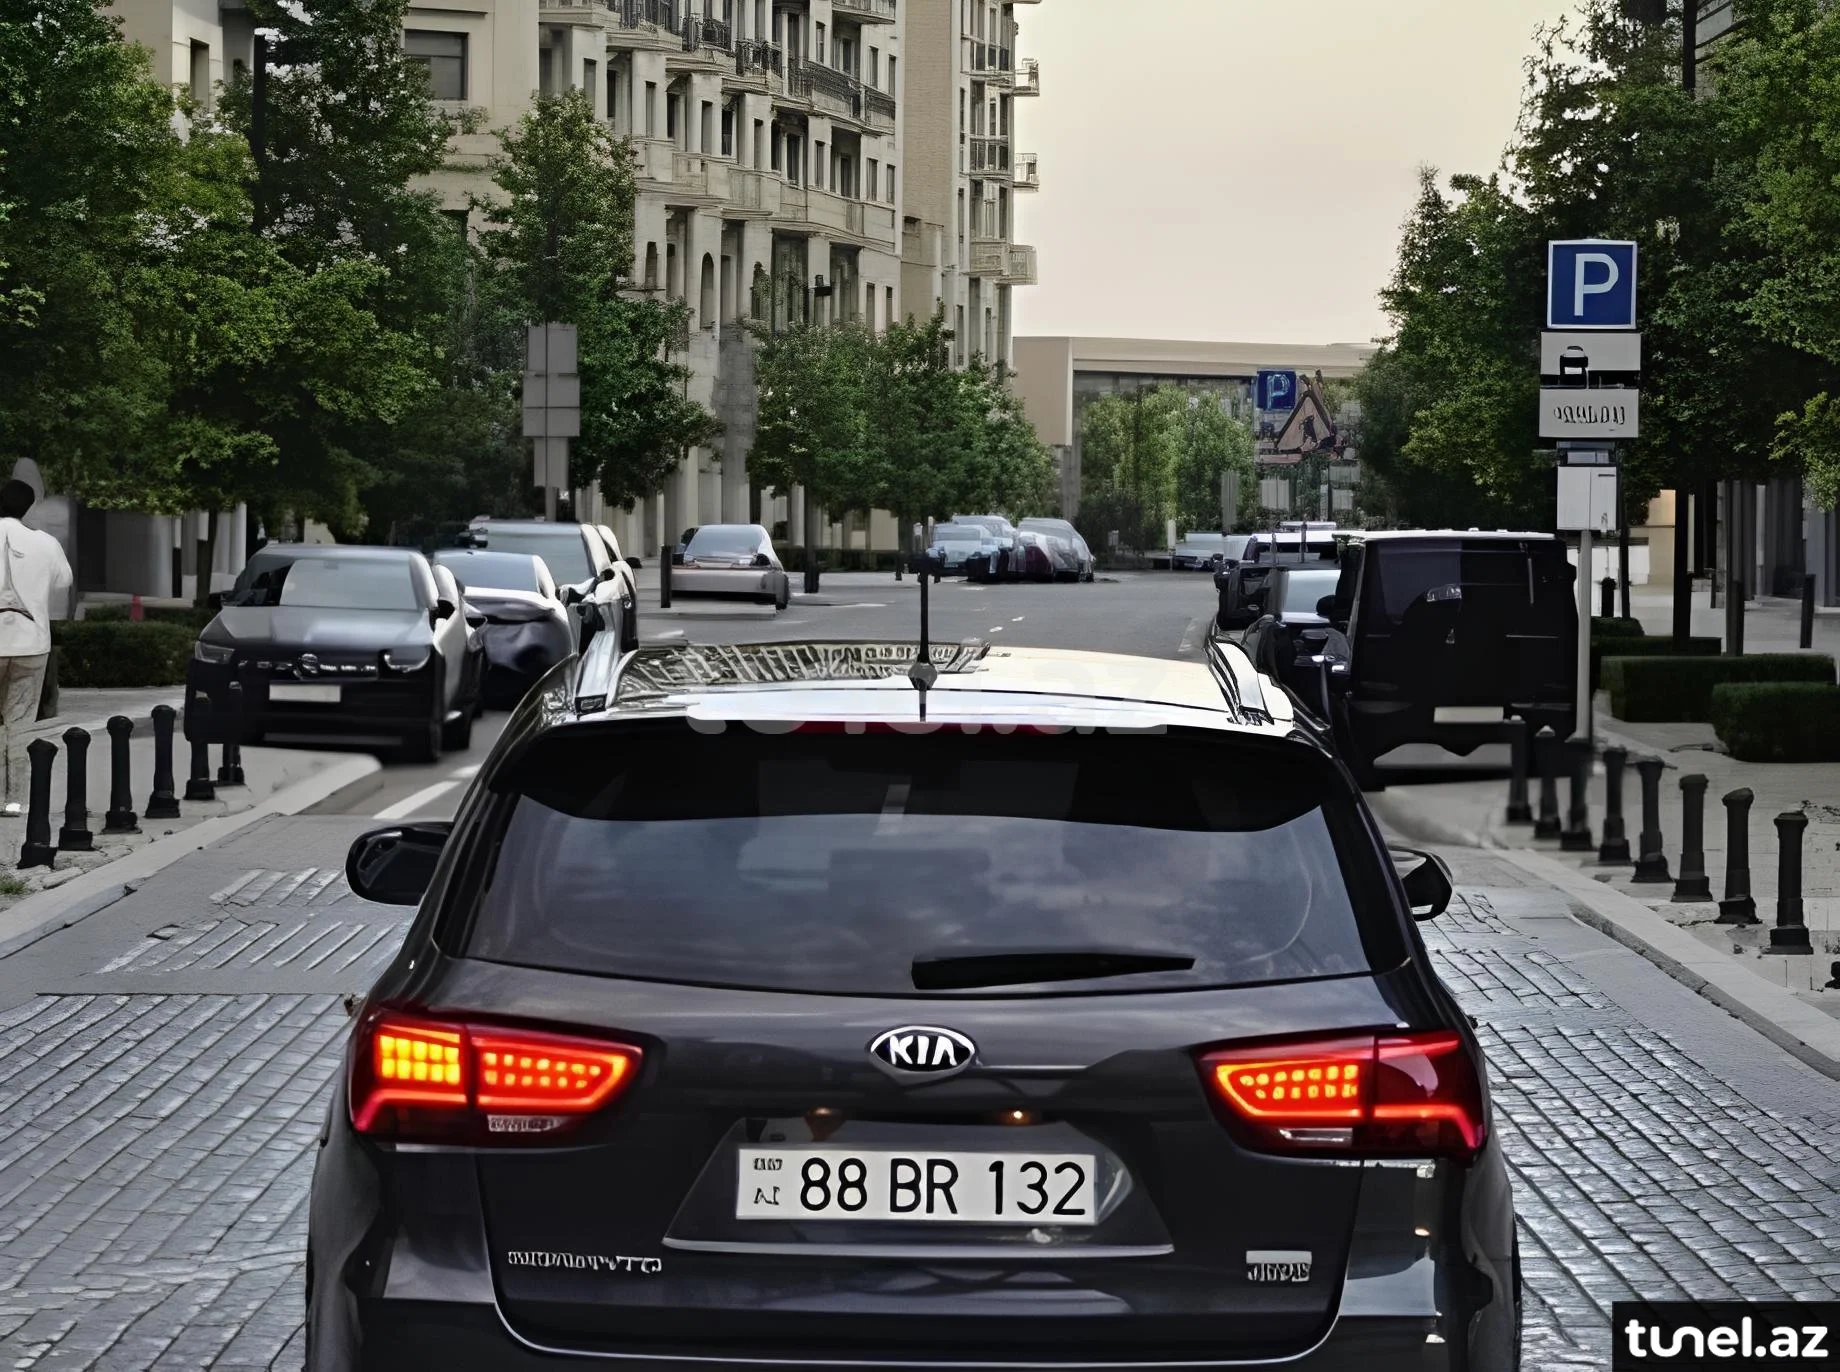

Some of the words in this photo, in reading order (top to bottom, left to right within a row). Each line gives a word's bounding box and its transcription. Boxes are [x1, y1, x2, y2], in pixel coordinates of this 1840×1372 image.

[1573, 252, 1619, 317] P
[1267, 374, 1291, 411] P
[889, 1034, 957, 1066] KIA
[799, 1156, 868, 1213] 88
[889, 1157, 959, 1215] BR
[988, 1159, 1086, 1216] 132
